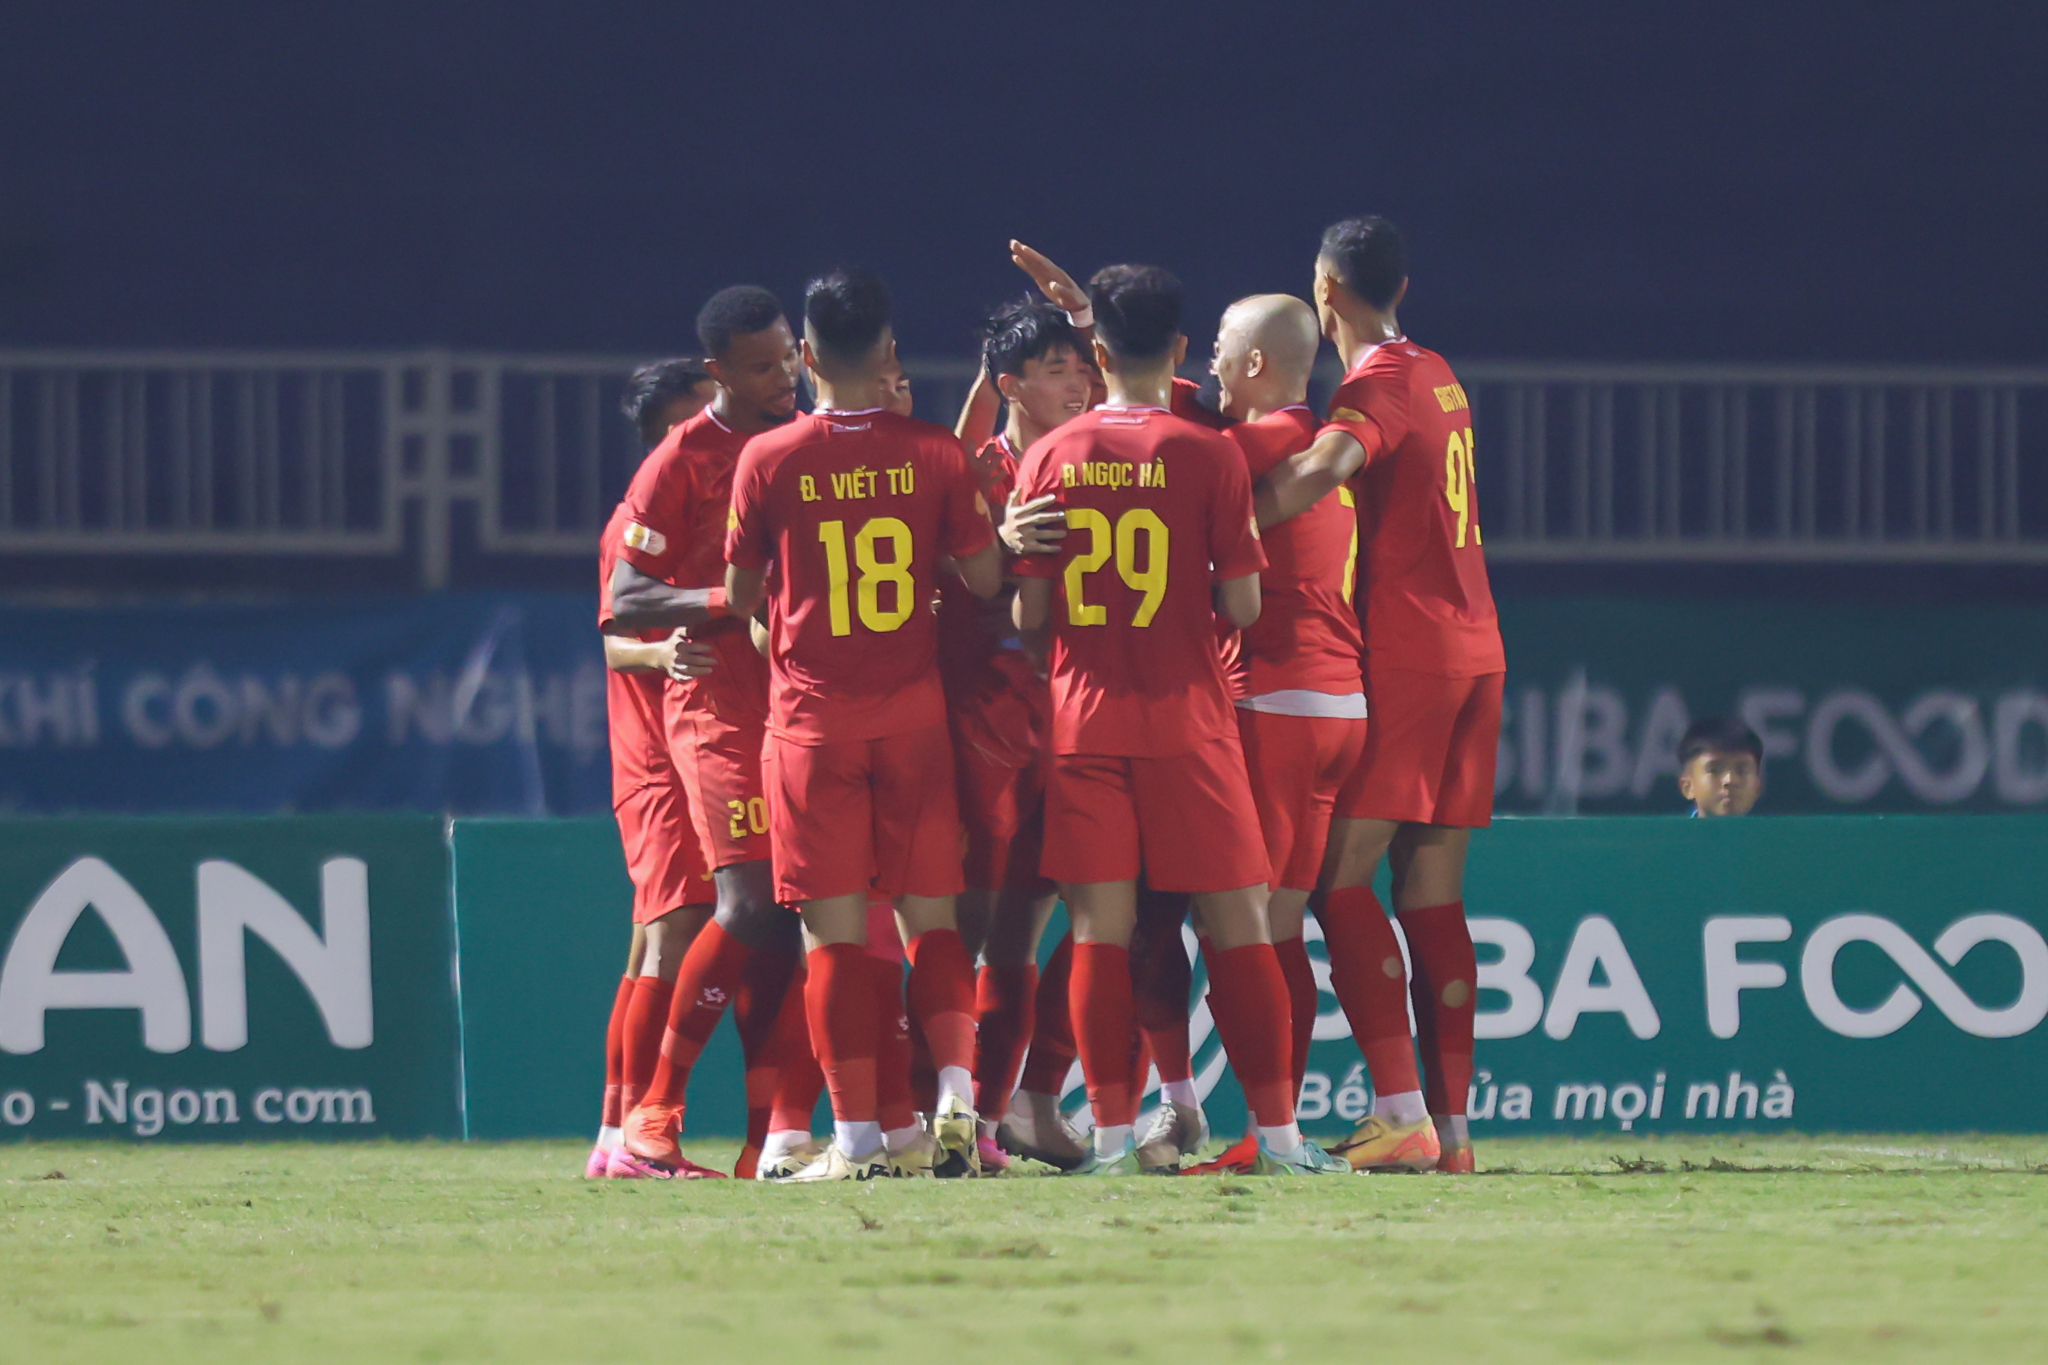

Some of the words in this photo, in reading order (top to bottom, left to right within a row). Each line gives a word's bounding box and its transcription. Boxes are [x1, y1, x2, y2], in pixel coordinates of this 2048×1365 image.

[830, 465, 878, 500] VIẾT
[886, 461, 914, 496] TÚ
[1138, 456, 1166, 488] HÀ
[819, 517, 915, 637] 18
[1063, 508, 1170, 627] 29
[122, 656, 364, 749] CÔNG
[727, 797, 770, 838] 20
[0, 857, 373, 1054] AN
[85, 1080, 240, 1136] Ngon
[1554, 1071, 1666, 1131] mọi
[1685, 1070, 1796, 1120] nhà
